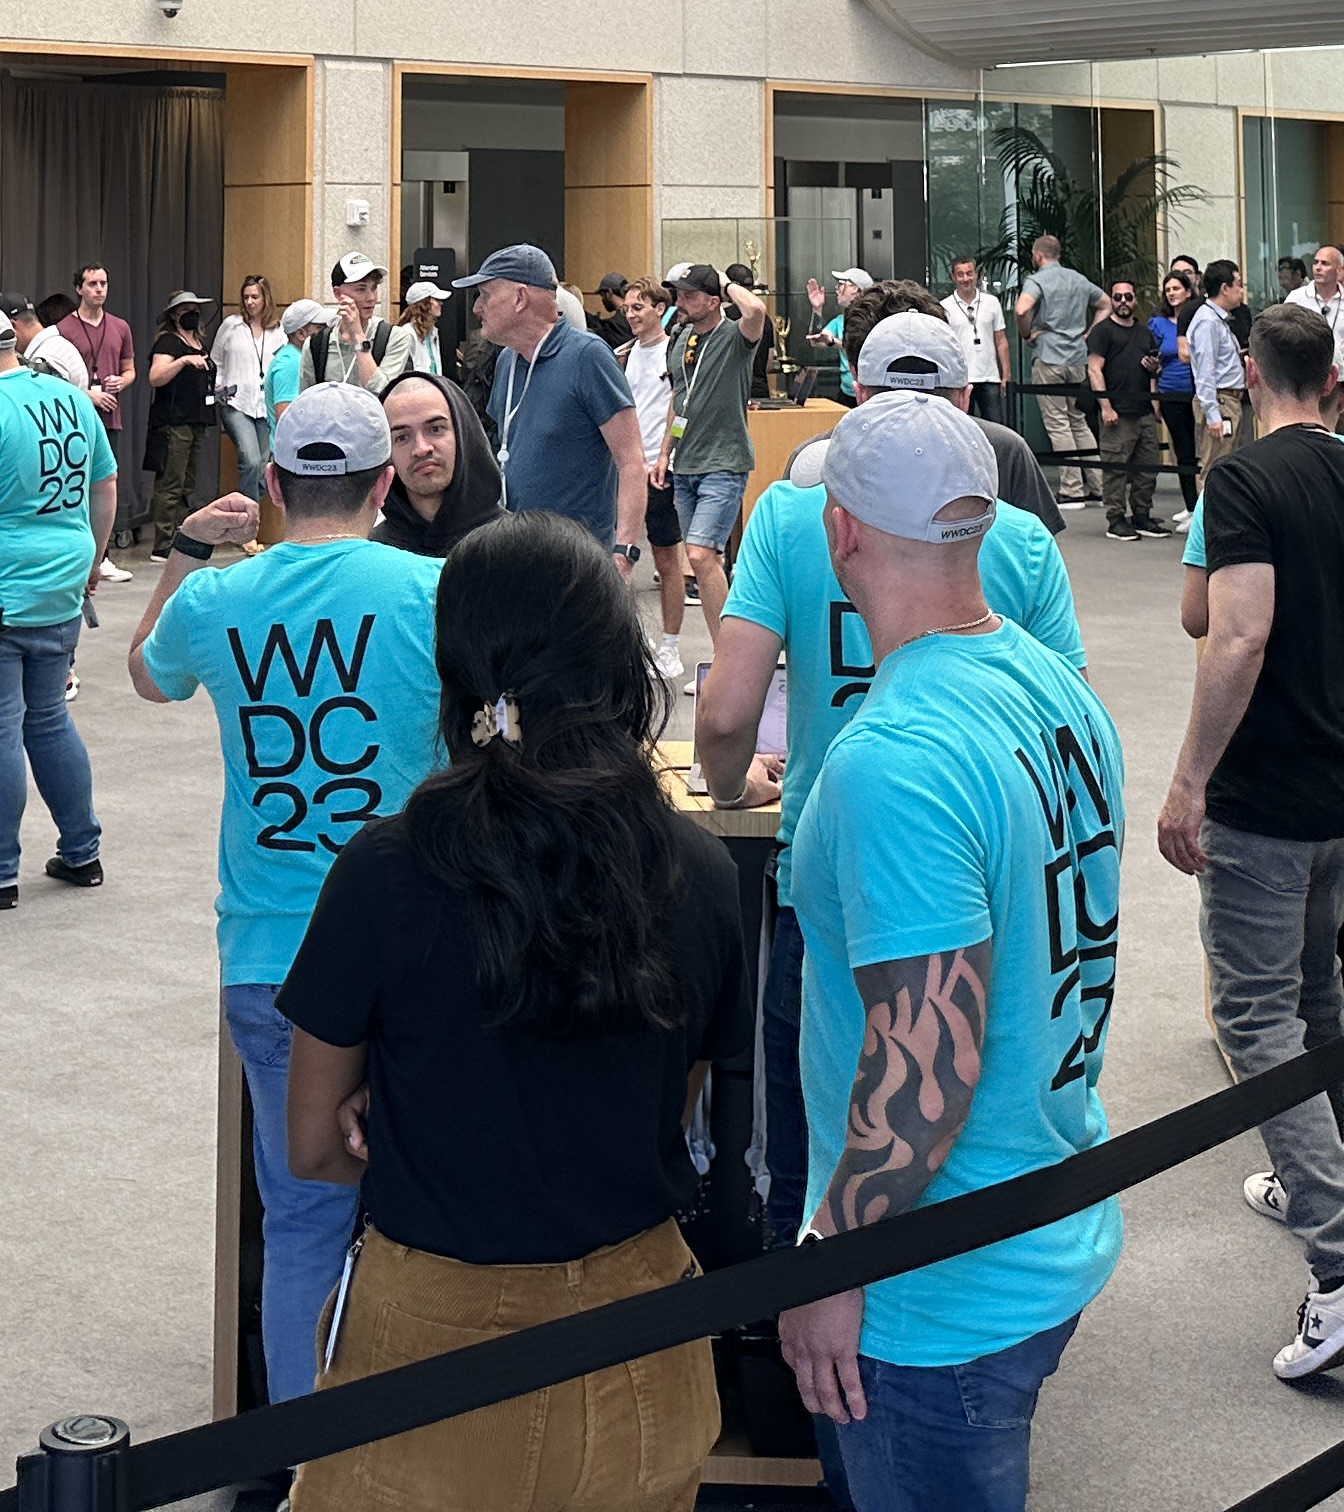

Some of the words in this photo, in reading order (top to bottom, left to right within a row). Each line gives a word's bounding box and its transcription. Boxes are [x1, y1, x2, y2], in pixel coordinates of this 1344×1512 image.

[889, 376, 925, 387] WWDC23
[38, 431, 88, 478] DC
[302, 463, 338, 472] WWDC23
[36, 470, 86, 516] 23
[941, 523, 984, 540] WWDC23
[238, 696, 380, 778] DC
[252, 777, 382, 855] 23
